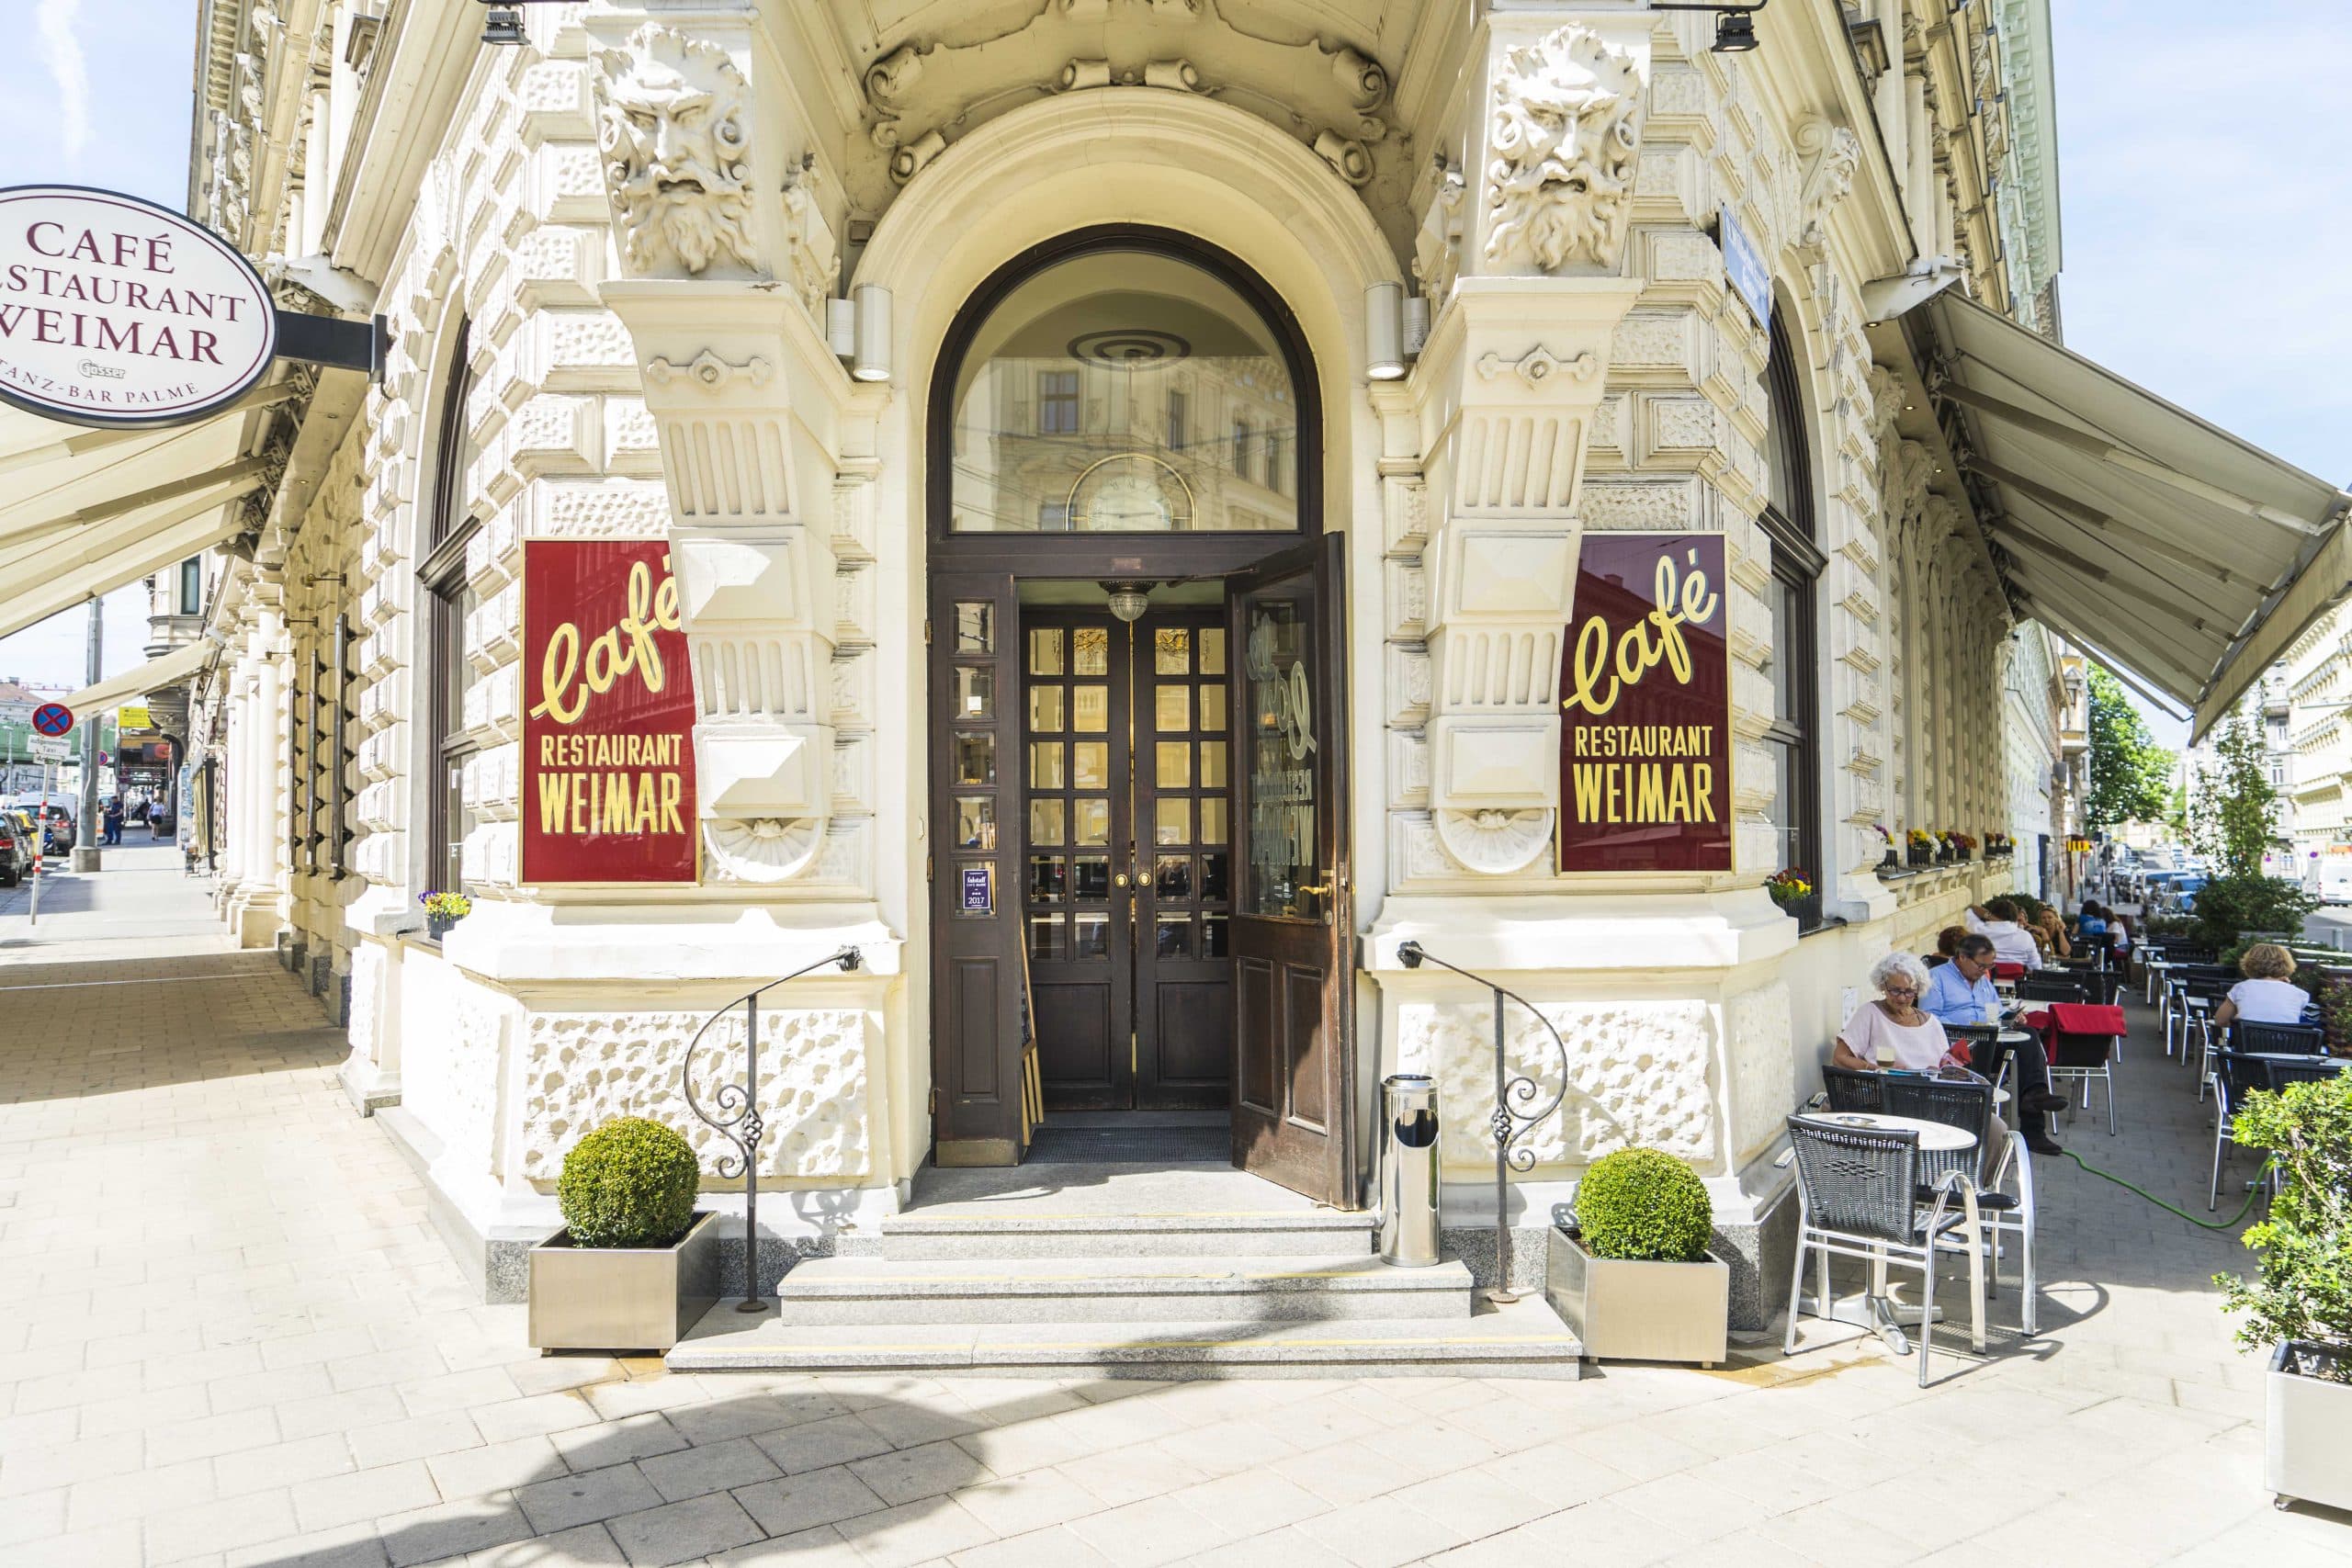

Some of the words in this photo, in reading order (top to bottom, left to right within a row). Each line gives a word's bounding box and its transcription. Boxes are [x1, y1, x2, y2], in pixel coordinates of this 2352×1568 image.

[26, 220, 175, 275] CAFÉ
[0, 264, 246, 322] STAURANT
[125, 382, 198, 403] PALME
[1563, 548, 1717, 716] Café
[541, 734, 683, 766] RESTAURANT
[1575, 726, 1713, 757] RESTAURANT
[537, 773, 685, 835] WEIMAR
[1573, 763, 1716, 823] WEIMAR
[968, 897, 985, 905] 2017
